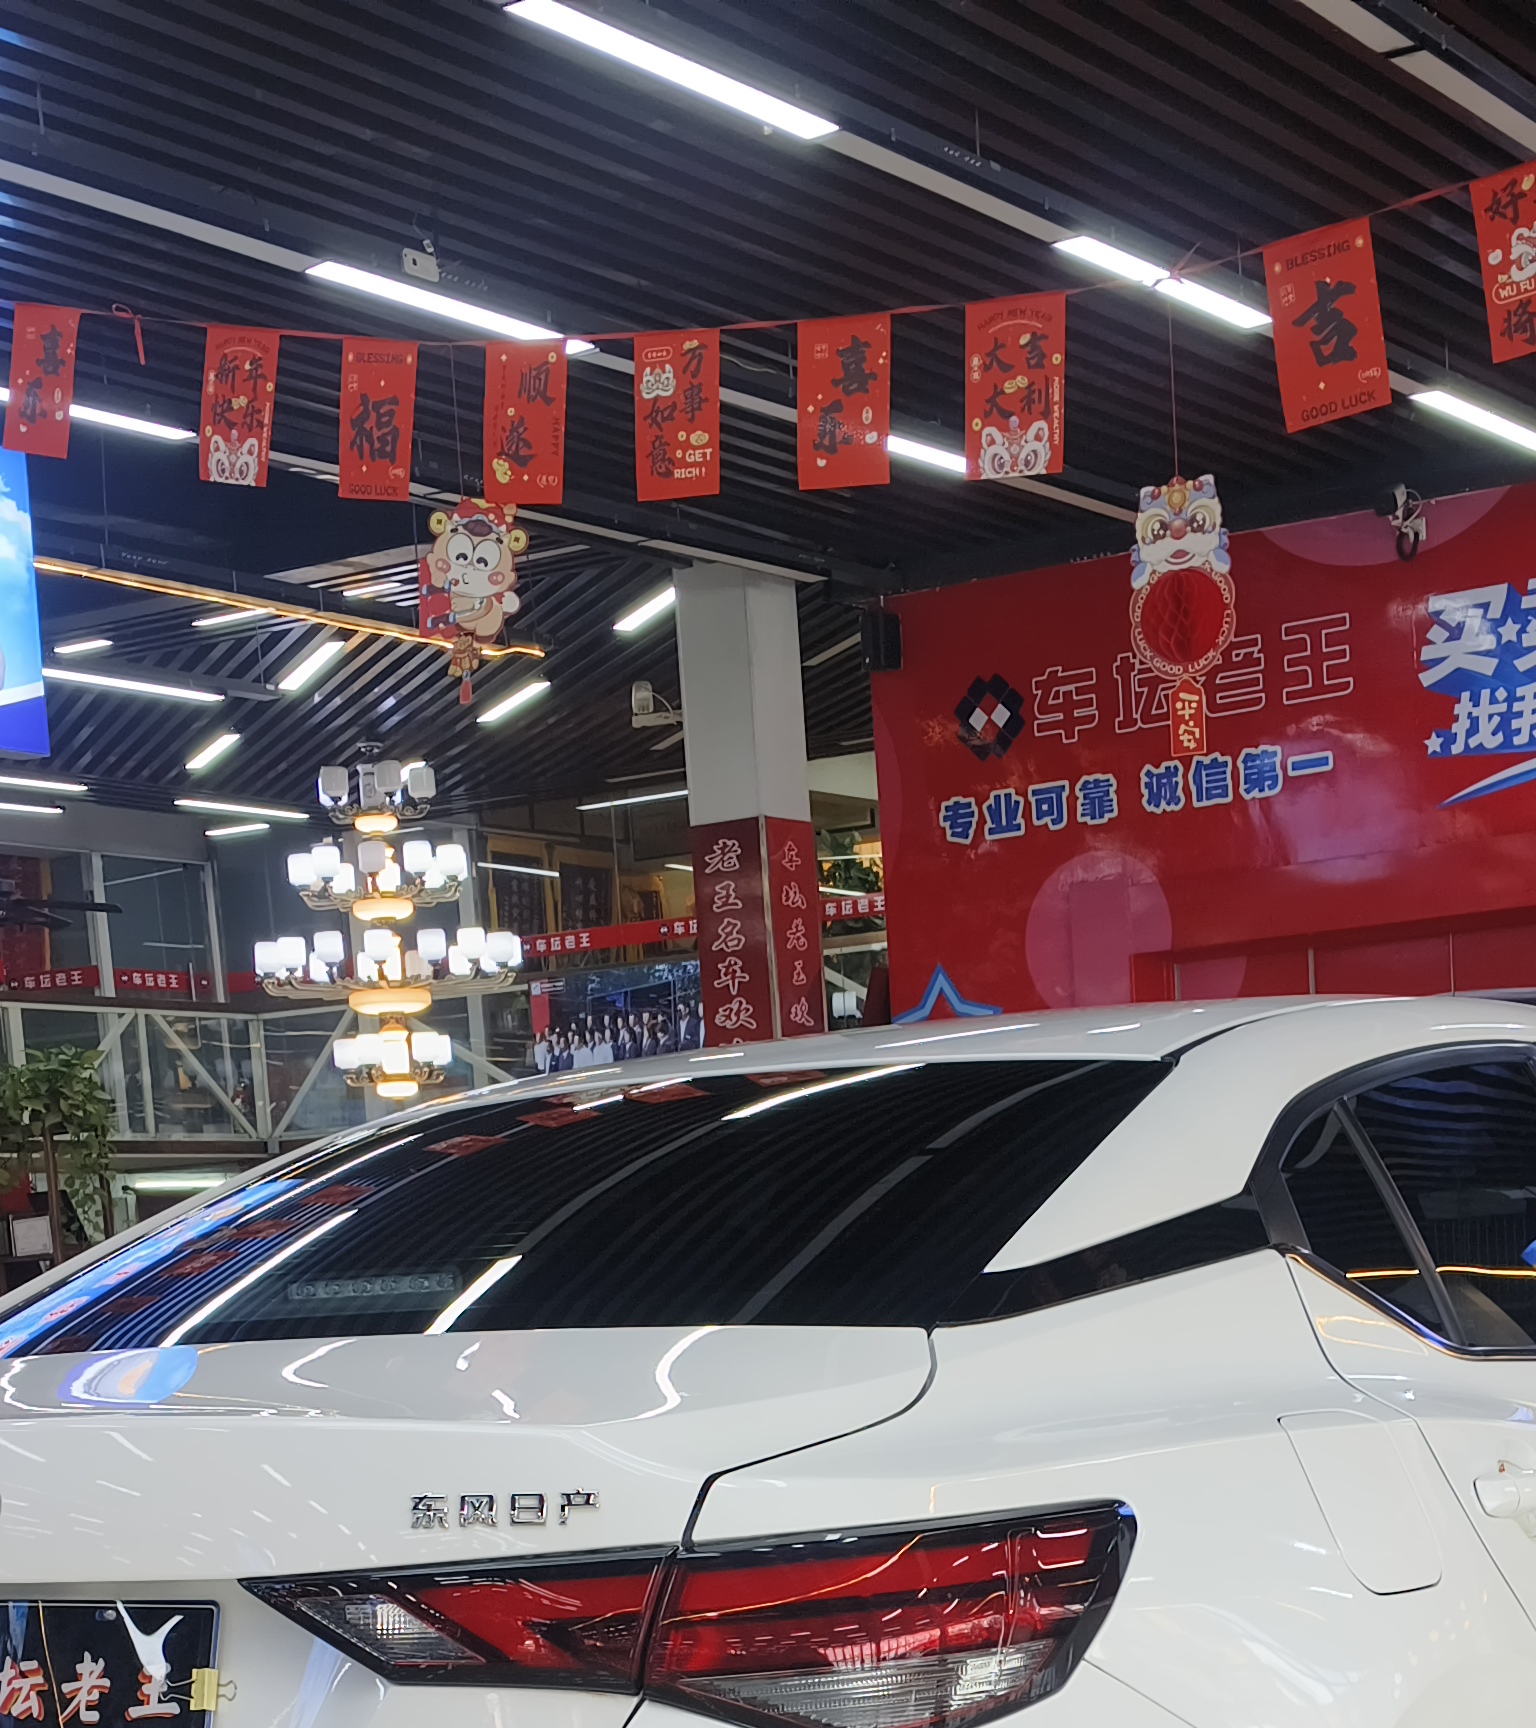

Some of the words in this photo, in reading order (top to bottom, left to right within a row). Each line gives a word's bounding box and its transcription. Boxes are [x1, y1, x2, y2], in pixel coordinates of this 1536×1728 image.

[1285, 239, 1351, 272] BLESSING
[1499, 284, 1516, 299] WU
[1520, 278, 1535, 291] FU
[1292, 279, 1359, 368] 吉
[983, 331, 1049, 374] 大吉
[983, 374, 1051, 421] 大利
[1301, 401, 1338, 423] GOOD
[1341, 390, 1376, 411] LUCK
[349, 393, 400, 464] 福
[685, 448, 713, 463] GET
[348, 484, 372, 496] GOOD
[374, 484, 399, 497] LUCK
[1134, 585, 1151, 622] GOOD
[1211, 570, 1231, 604] GOOD
[1135, 627, 1154, 660] LUCK
[1217, 609, 1232, 646] LUCK
[1153, 657, 1183, 675] GOOD
[1188, 648, 1216, 672] LUCK
[1175, 691, 1200, 750] 平安
[940, 773, 1119, 844] 专业可靠
[1140, 745, 1334, 813] 诚信第一
[535, 932, 591, 953] 车坛老王
[704, 838, 757, 1046] 老王名车欢
[409, 1487, 603, 1530] 东风日产
